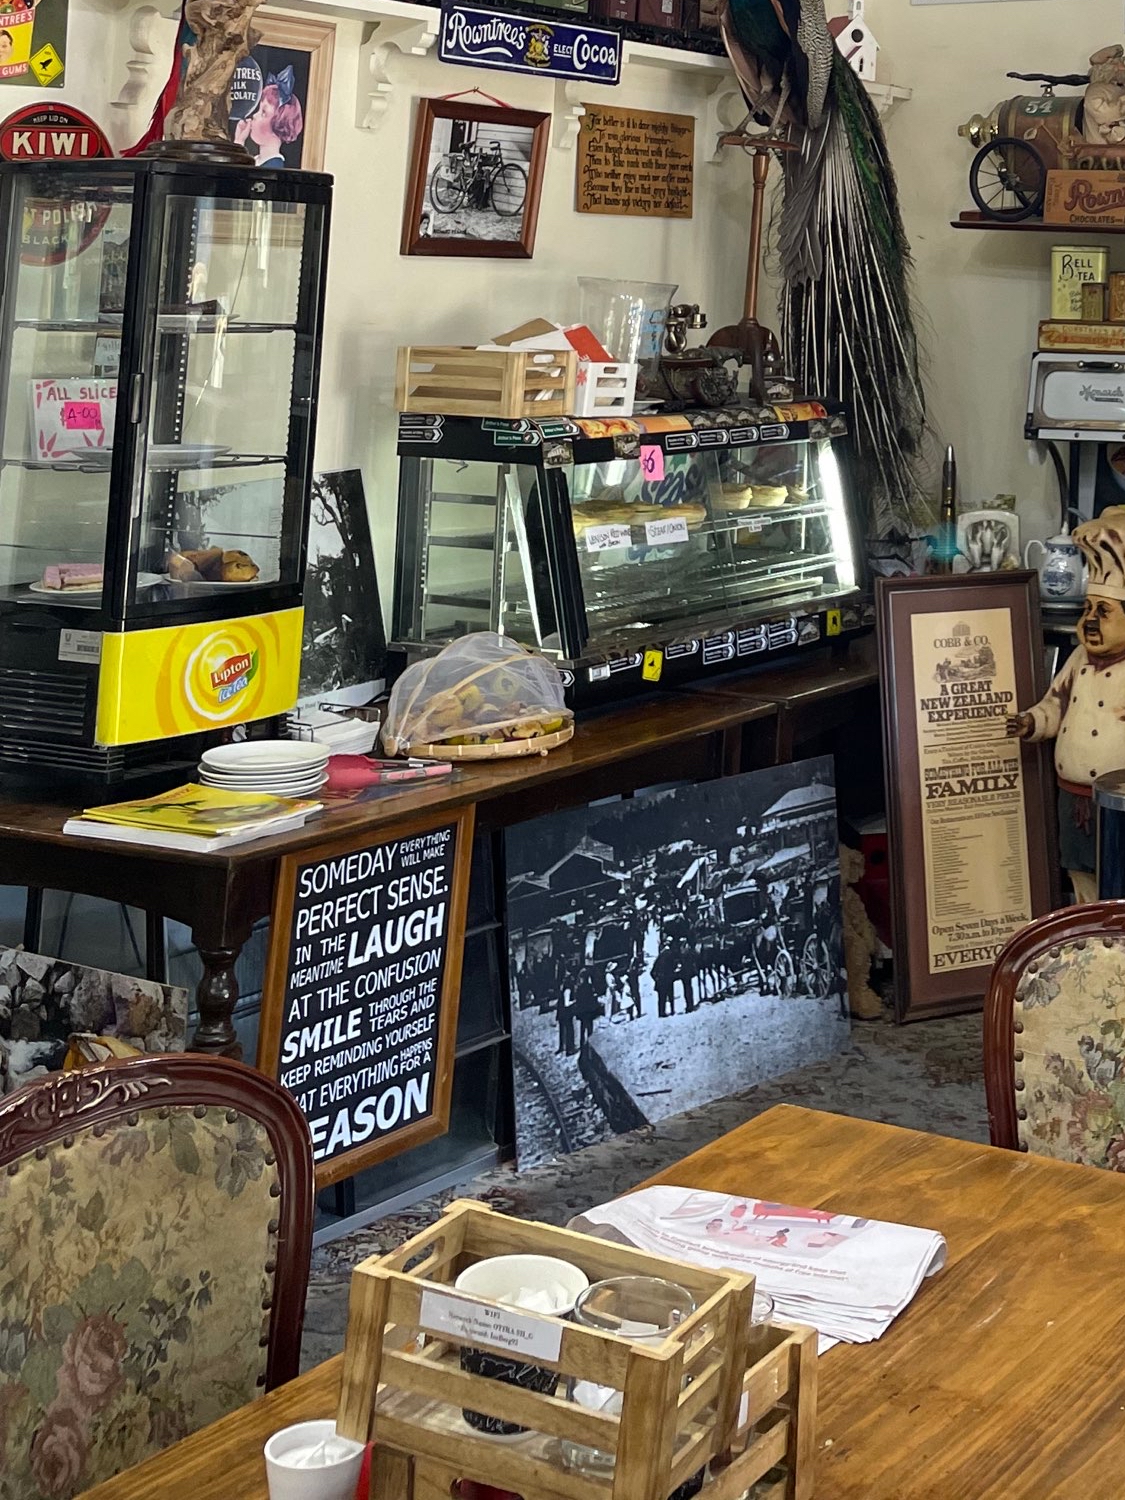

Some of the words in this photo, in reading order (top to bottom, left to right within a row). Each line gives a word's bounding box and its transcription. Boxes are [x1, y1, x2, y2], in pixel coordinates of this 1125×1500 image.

[447, 11, 526, 58] Rowntree's
[573, 33, 618, 70] Cocoa
[2, 63, 28, 76] GUMS
[230, 81, 247, 90] ILK
[1025, 101, 1053, 114] 54
[12, 131, 89, 156] KIWI
[1069, 214, 1115, 225] CHOCOLATES
[1062, 253, 1093, 281] BELL
[1078, 271, 1095, 281] TEA
[46, 386, 72, 401] ALL
[933, 637, 961, 649] COBB
[964, 636, 972, 646] &
[213, 657, 250, 684] Lipton
[940, 684, 949, 696] A
[950, 680, 993, 694] GREAT
[920, 696, 951, 711] NEW
[953, 691, 1014, 707] ZEALAND
[927, 704, 1008, 723] EXPERIENCE
[925, 773, 1019, 799] FAMILY
[400, 829, 451, 854] EVERYTHING
[400, 853, 421, 868] WILL
[422, 844, 445, 861] MAKE
[299, 843, 398, 898] SOMEDAY
[296, 884, 384, 940] PERFECT
[387, 865, 449, 910] SENSE.
[347, 902, 446, 968] LAUGH
[932, 925, 954, 936] Open
[295, 944, 312, 966] IN
[320, 932, 347, 956] THE
[933, 943, 1005, 968] EVERYO
[288, 993, 313, 1023] AT
[317, 980, 350, 1012] THE
[354, 947, 442, 999] CONFUSION
[290, 956, 345, 990] MEANTIME
[368, 988, 416, 1018] THROUGH
[418, 977, 438, 993] THE
[369, 1006, 408, 1033] TEARS
[410, 993, 436, 1017] AND
[281, 1007, 363, 1064] SMILE
[280, 1063, 312, 1089] KEEP
[314, 1036, 383, 1078] REMINDING
[385, 1013, 436, 1049] YOURSELF
[400, 1037, 433, 1062] HAPPENS
[399, 1055, 421, 1075] FOR
[423, 1051, 432, 1064] A
[319, 1055, 399, 1108] EVERYTHING
[308, 1071, 431, 1160] EASON
